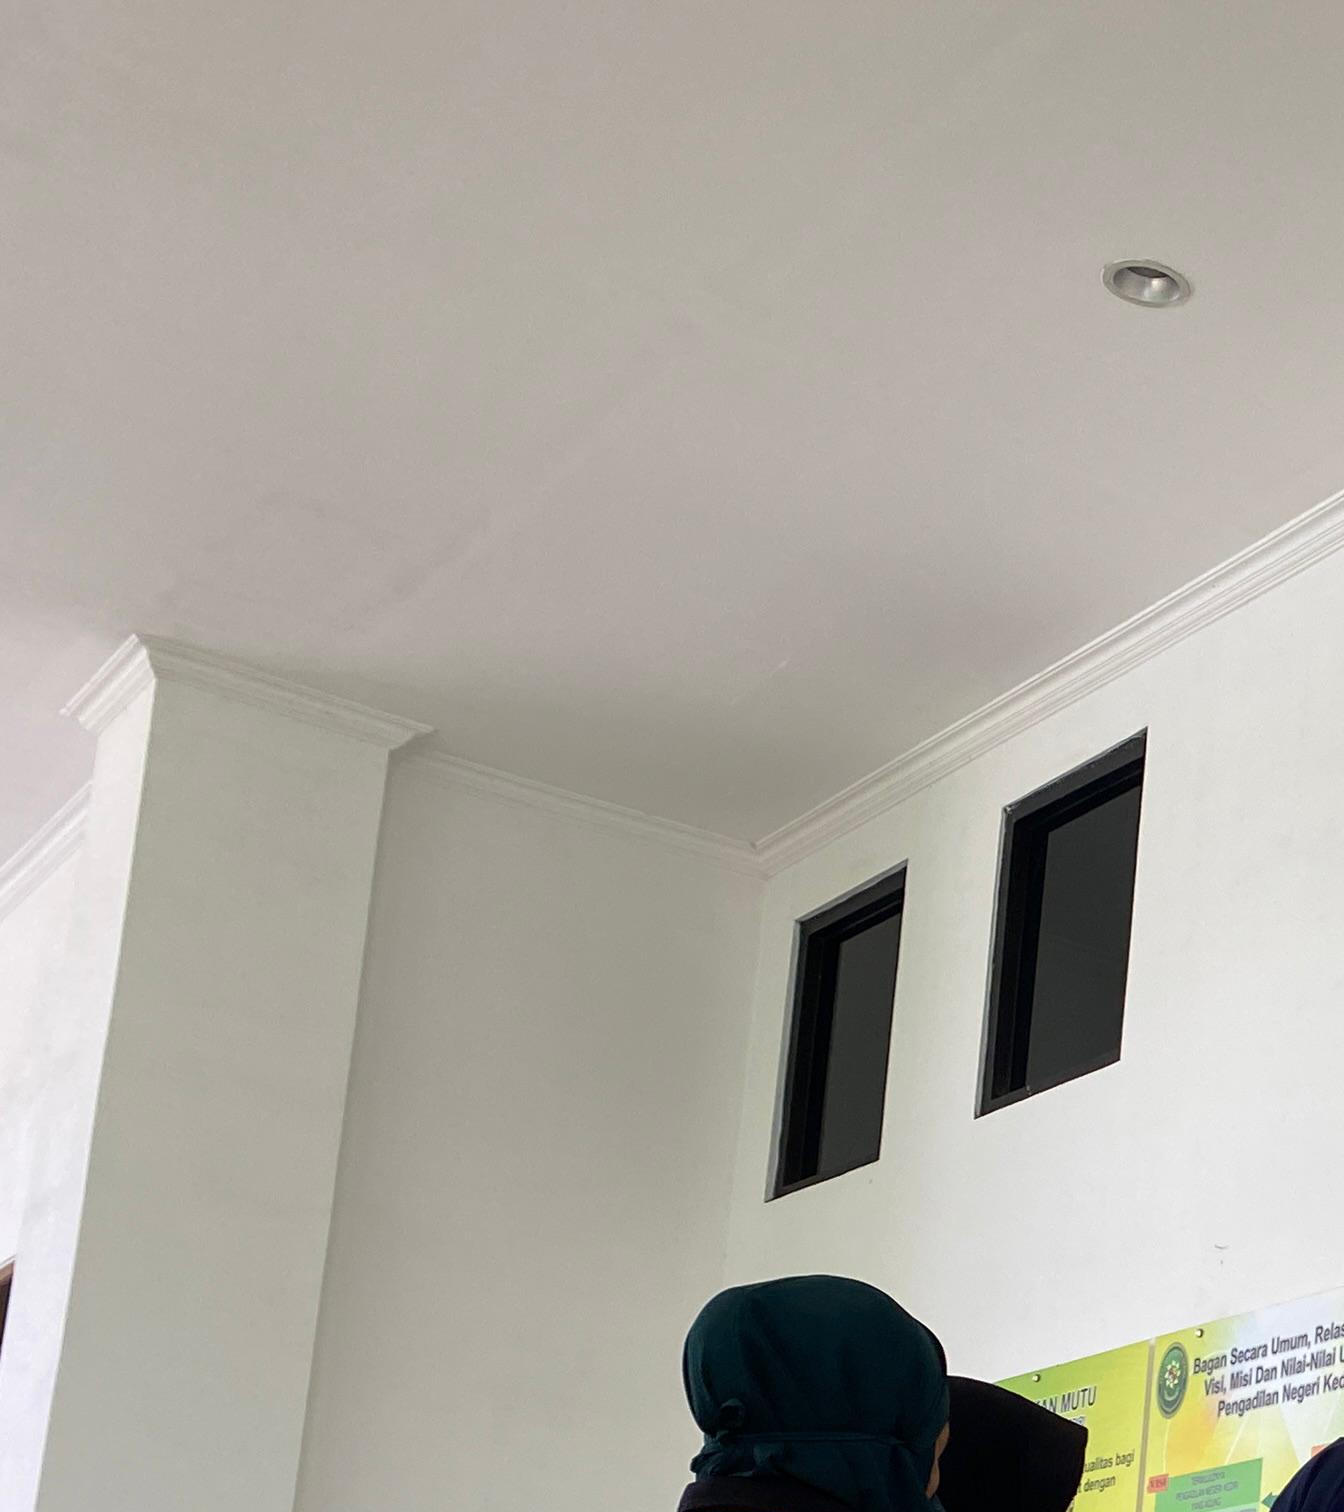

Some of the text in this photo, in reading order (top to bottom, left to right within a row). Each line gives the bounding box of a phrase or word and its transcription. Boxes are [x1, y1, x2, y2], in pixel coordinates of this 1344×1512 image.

[1193, 1353, 1227, 1375] Bagan
[1230, 1342, 1268, 1365] Secara
[1271, 1333, 1311, 1354] Umum,
[1204, 1375, 1227, 1396] Visi,
[1230, 1368, 1252, 1390] Misi
[1255, 1364, 1277, 1385] Dan
[1280, 1348, 1336, 1378] Nilai-Nilai
[1060, 1386, 1097, 1413] MUTU
[1217, 1390, 1279, 1418] Pengadilan
[1282, 1379, 1320, 1403] Negeri
[1084, 1449, 1136, 1473] ualitas bagi
[1084, 1475, 1116, 1494] dengan
